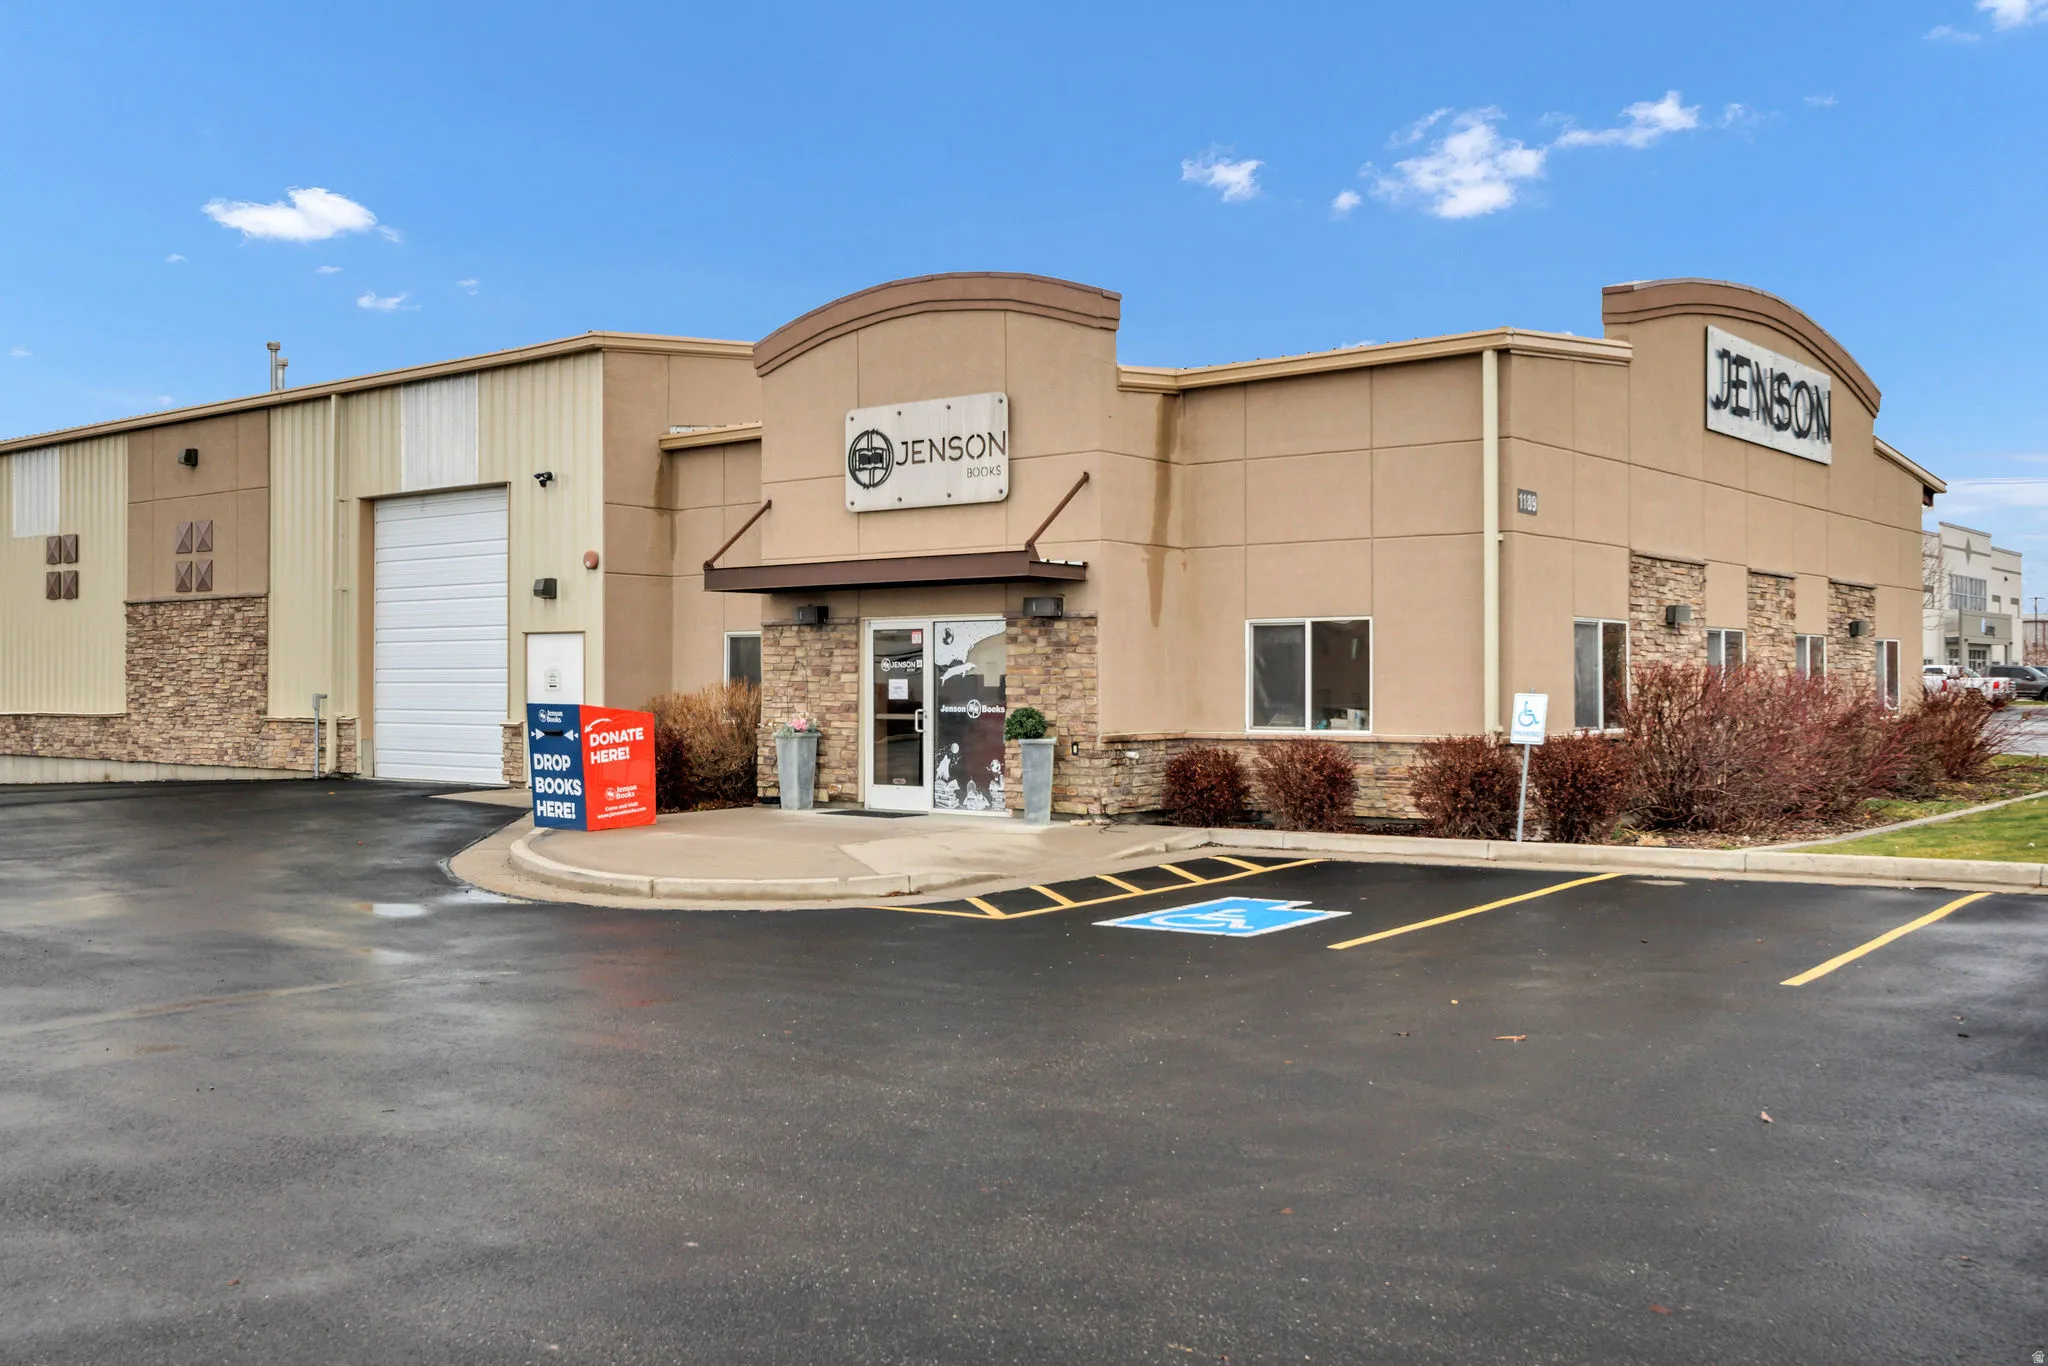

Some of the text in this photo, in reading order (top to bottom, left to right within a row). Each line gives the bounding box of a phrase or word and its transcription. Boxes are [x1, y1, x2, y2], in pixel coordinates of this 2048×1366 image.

[1711, 347, 1832, 444] JENSON
[895, 430, 1007, 467] JENSON
[966, 465, 1002, 479] BOOKS
[1518, 493, 1537, 512] 1189
[889, 661, 916, 669] JENSON
[547, 709, 563, 717] Jenson
[940, 704, 1006, 713] Jenson Books
[589, 727, 644, 747] DONATE
[533, 753, 571, 772] DROP
[590, 747, 630, 764] HERE!
[535, 777, 582, 796] BOOKS
[615, 790, 636, 800] Books
[616, 784, 638, 793] Jenson
[536, 799, 577, 820] HERE!
